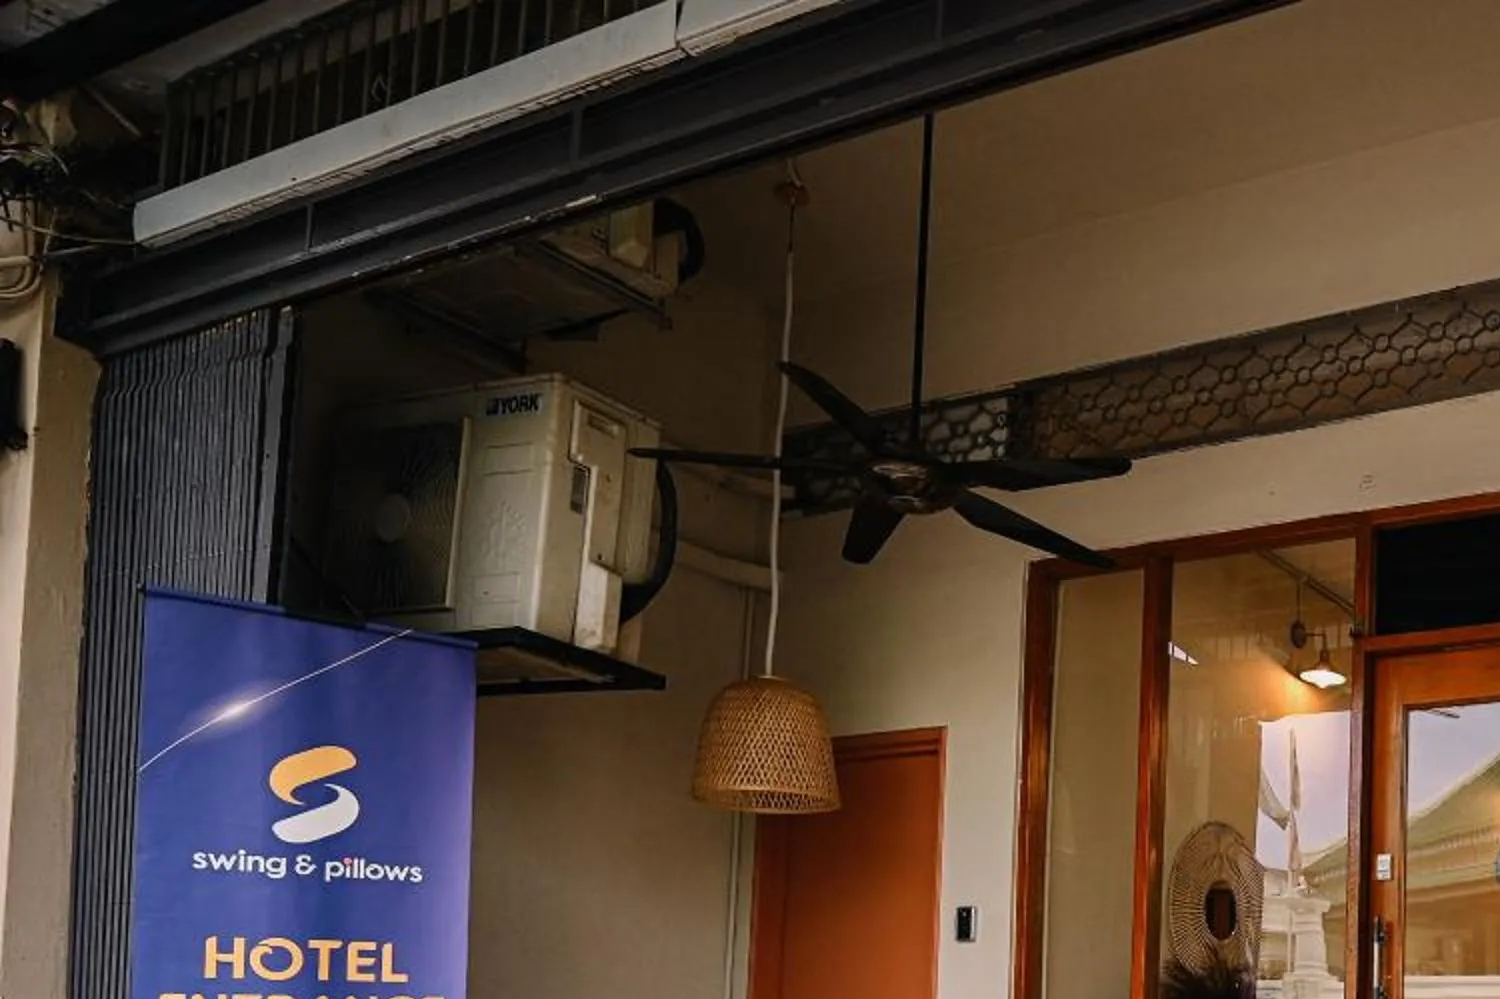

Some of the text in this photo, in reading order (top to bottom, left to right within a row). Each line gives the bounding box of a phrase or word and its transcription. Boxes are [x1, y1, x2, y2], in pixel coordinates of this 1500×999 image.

[501, 393, 542, 415] YORK
[192, 850, 423, 883] swing & pillows
[203, 935, 409, 983] HOTEL
